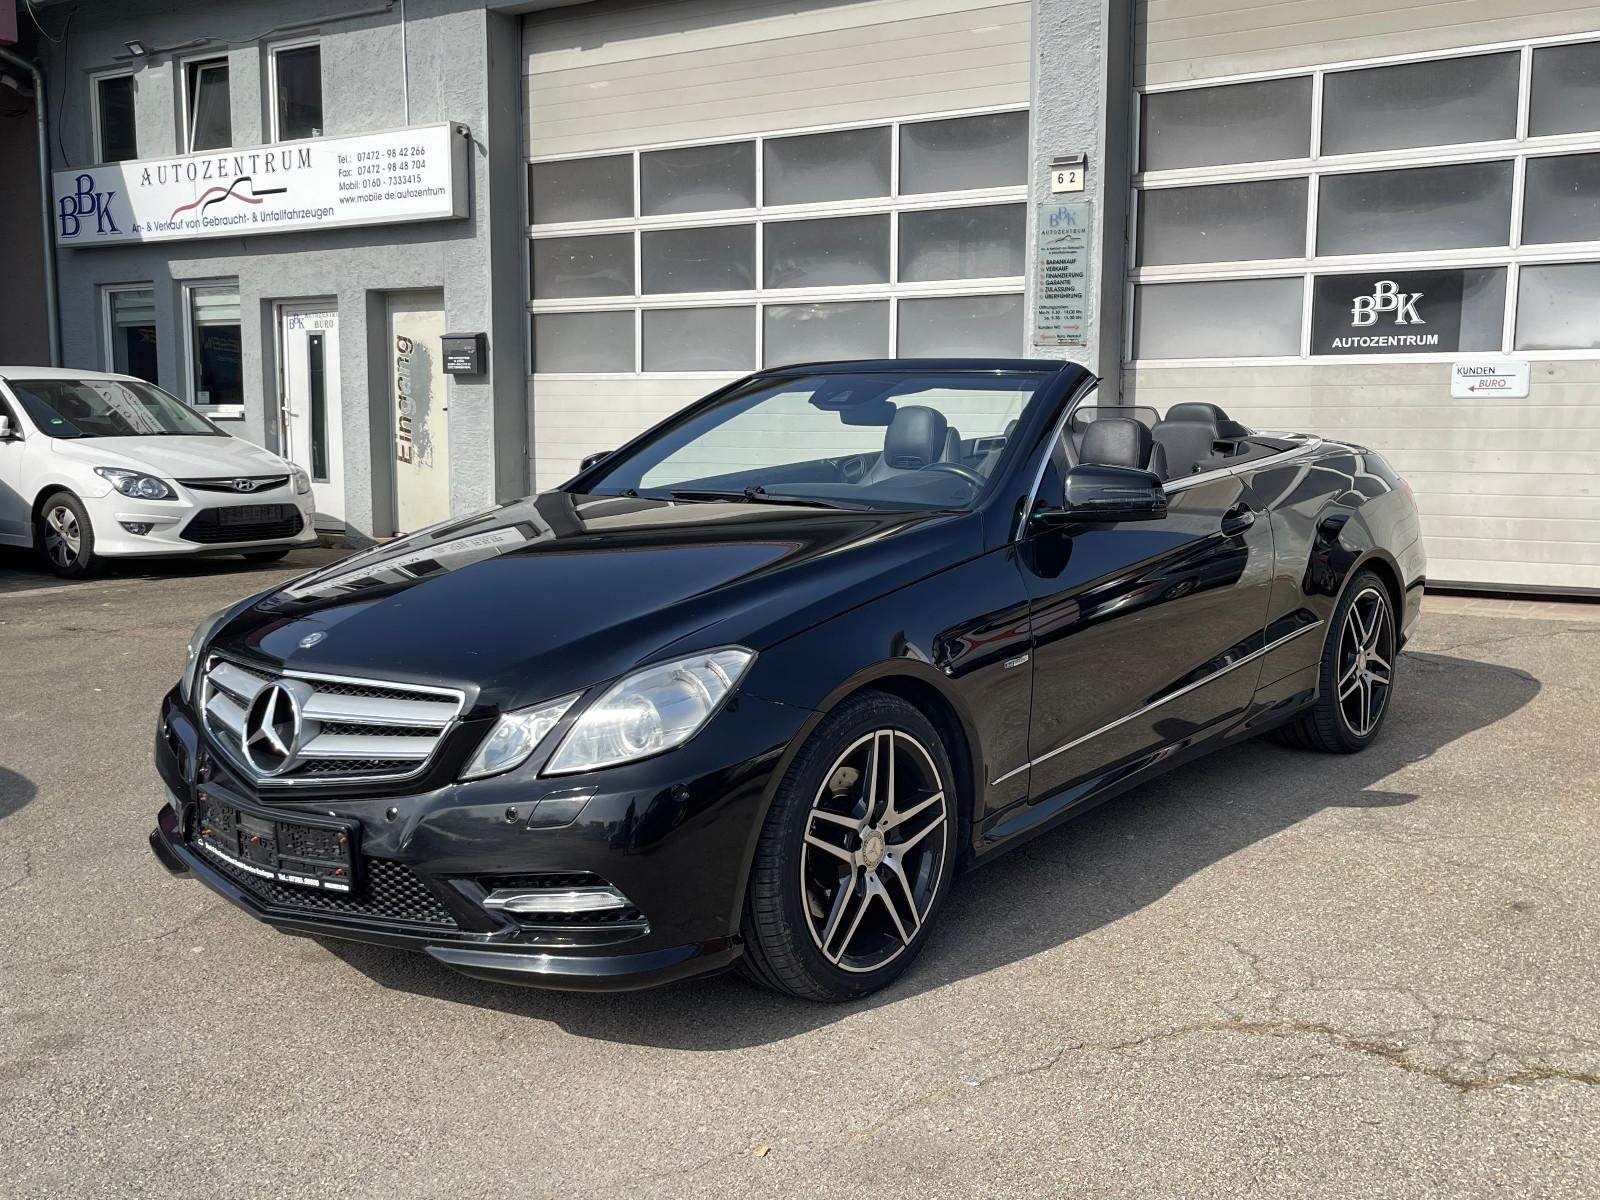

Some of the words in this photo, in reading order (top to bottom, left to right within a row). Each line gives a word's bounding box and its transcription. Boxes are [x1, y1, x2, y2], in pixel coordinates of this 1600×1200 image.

[357, 151, 380, 162] 07472
[387, 148, 397, 158] 98
[399, 148, 408, 156] 42
[411, 146, 426, 156] 266
[140, 148, 312, 186] AUTOZENTRUM
[357, 164, 380, 175] 07472
[387, 162, 397, 172] 98
[399, 162, 408, 170] 48
[412, 160, 426, 169] 704
[339, 180, 360, 191] Mobil:
[362, 178, 381, 188] 0160
[388, 174, 422, 186] 7333415
[59, 174, 122, 238] BBK
[132, 224, 145, 233] An-
[147, 222, 152, 232] &
[154, 220, 183, 231] Verkauf
[185, 220, 200, 229] von
[202, 213, 250, 226] Gebraucht-
[252, 212, 258, 222] &
[260, 206, 334, 222] Unfallfahrzeugen
[1350, 280, 1426, 327] BBK
[1332, 334, 1438, 348] AUTOZENTRUM
[1457, 366, 1496, 375] KUNDEN
[1479, 378, 1506, 387] BÜRO
[396, 334, 416, 464] Eingang
